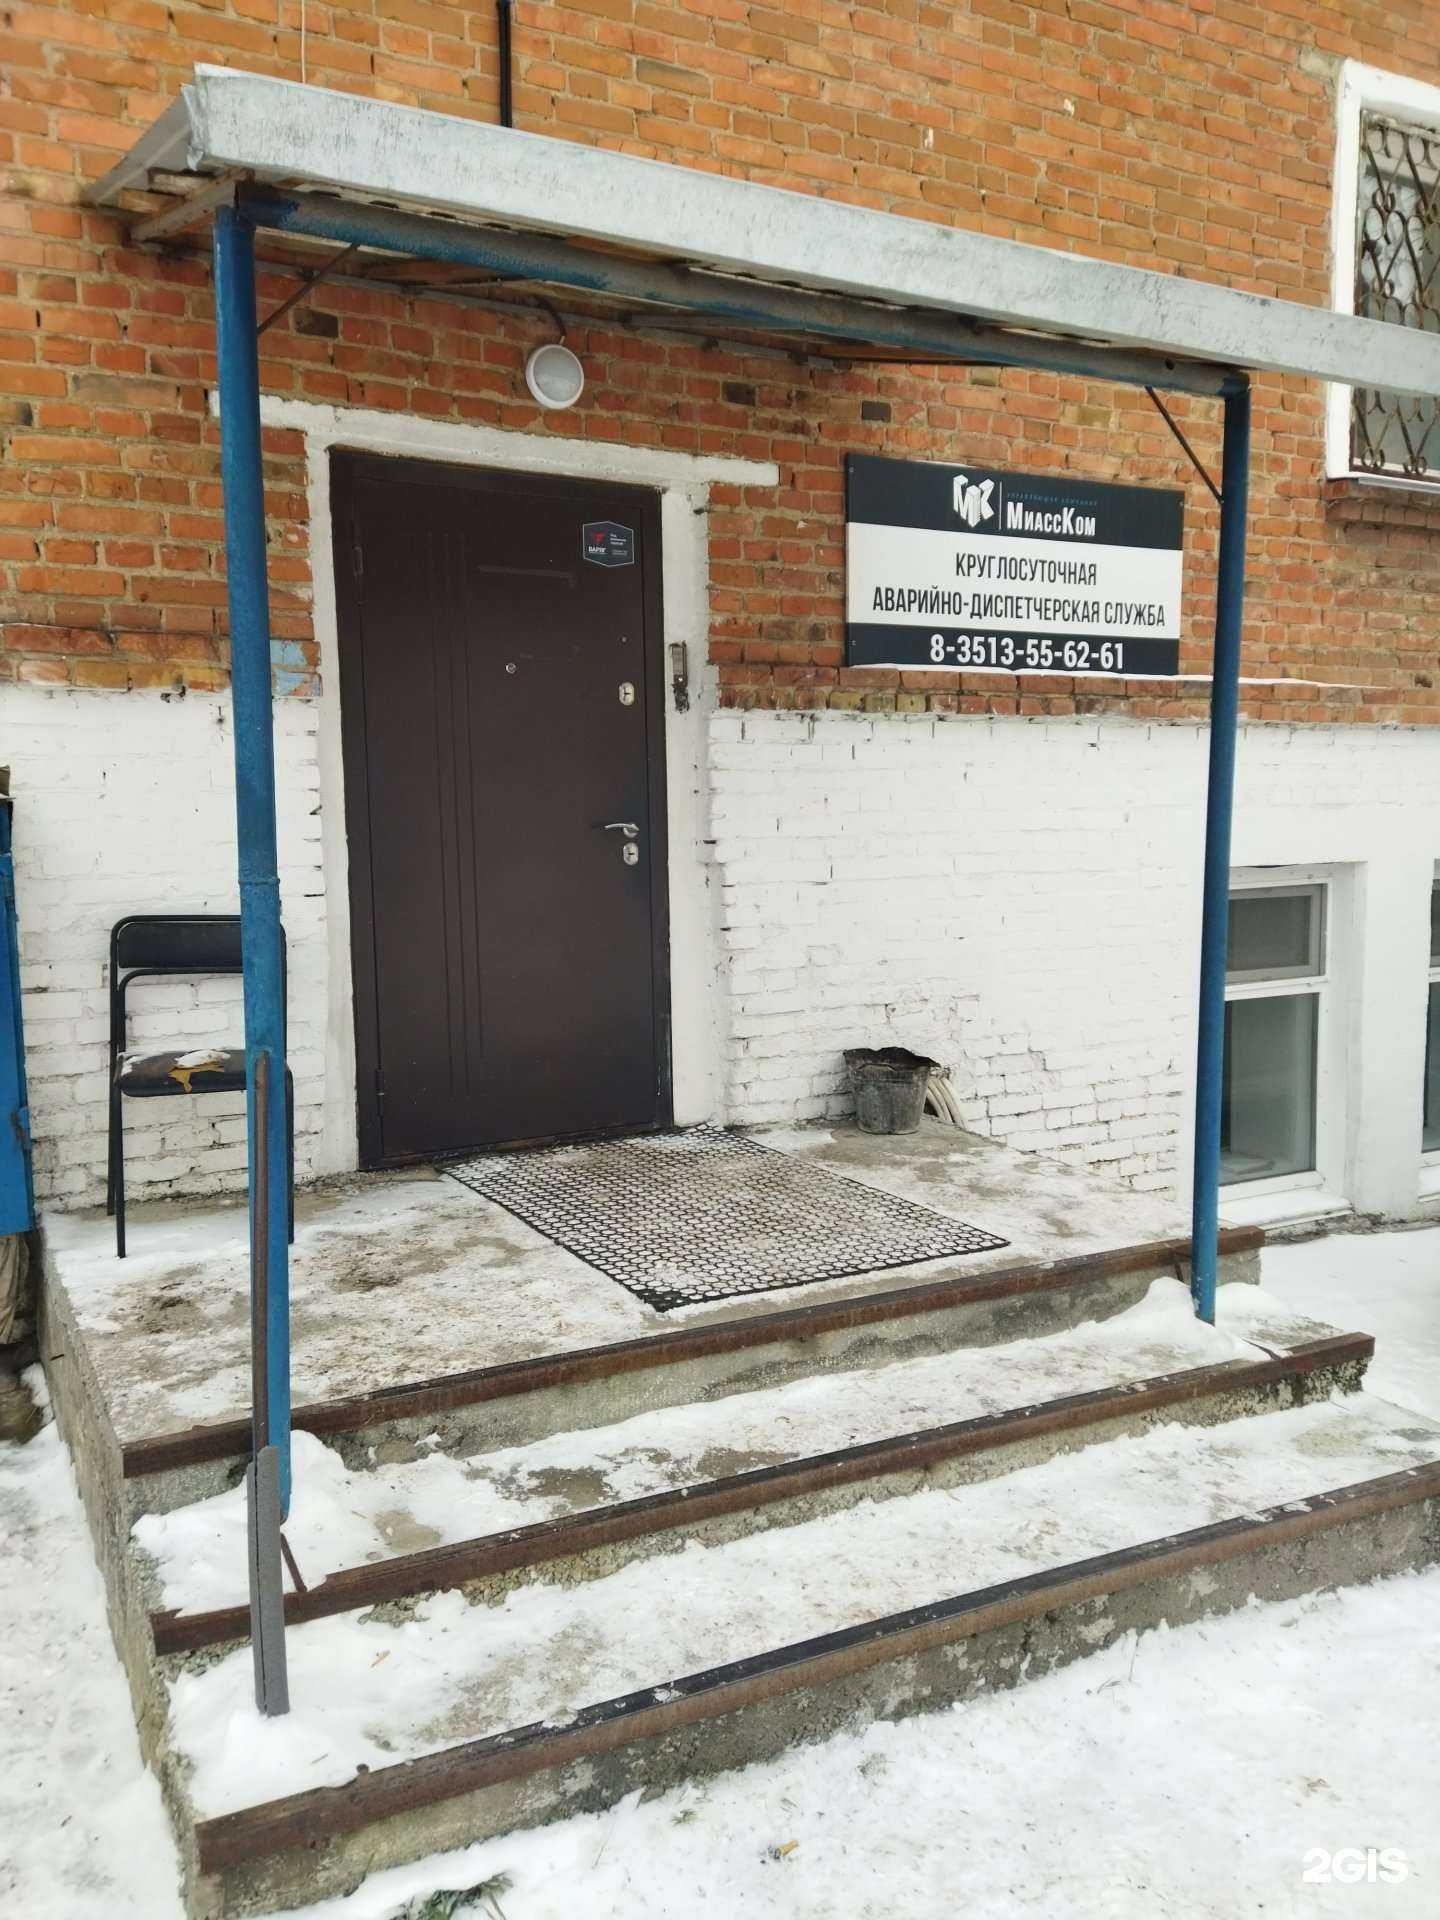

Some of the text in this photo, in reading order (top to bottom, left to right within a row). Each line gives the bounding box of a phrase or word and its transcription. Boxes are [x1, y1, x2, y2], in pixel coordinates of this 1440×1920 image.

[955, 552, 1097, 585] КРУГЛОСУТОЧНАЯ
[872, 585, 1166, 626] АВАРИЙНО-ДИСПЕТЧЕРСКАЯ СЛУЖБА
[930, 633, 1124, 669] 8-3513-55-62-61
